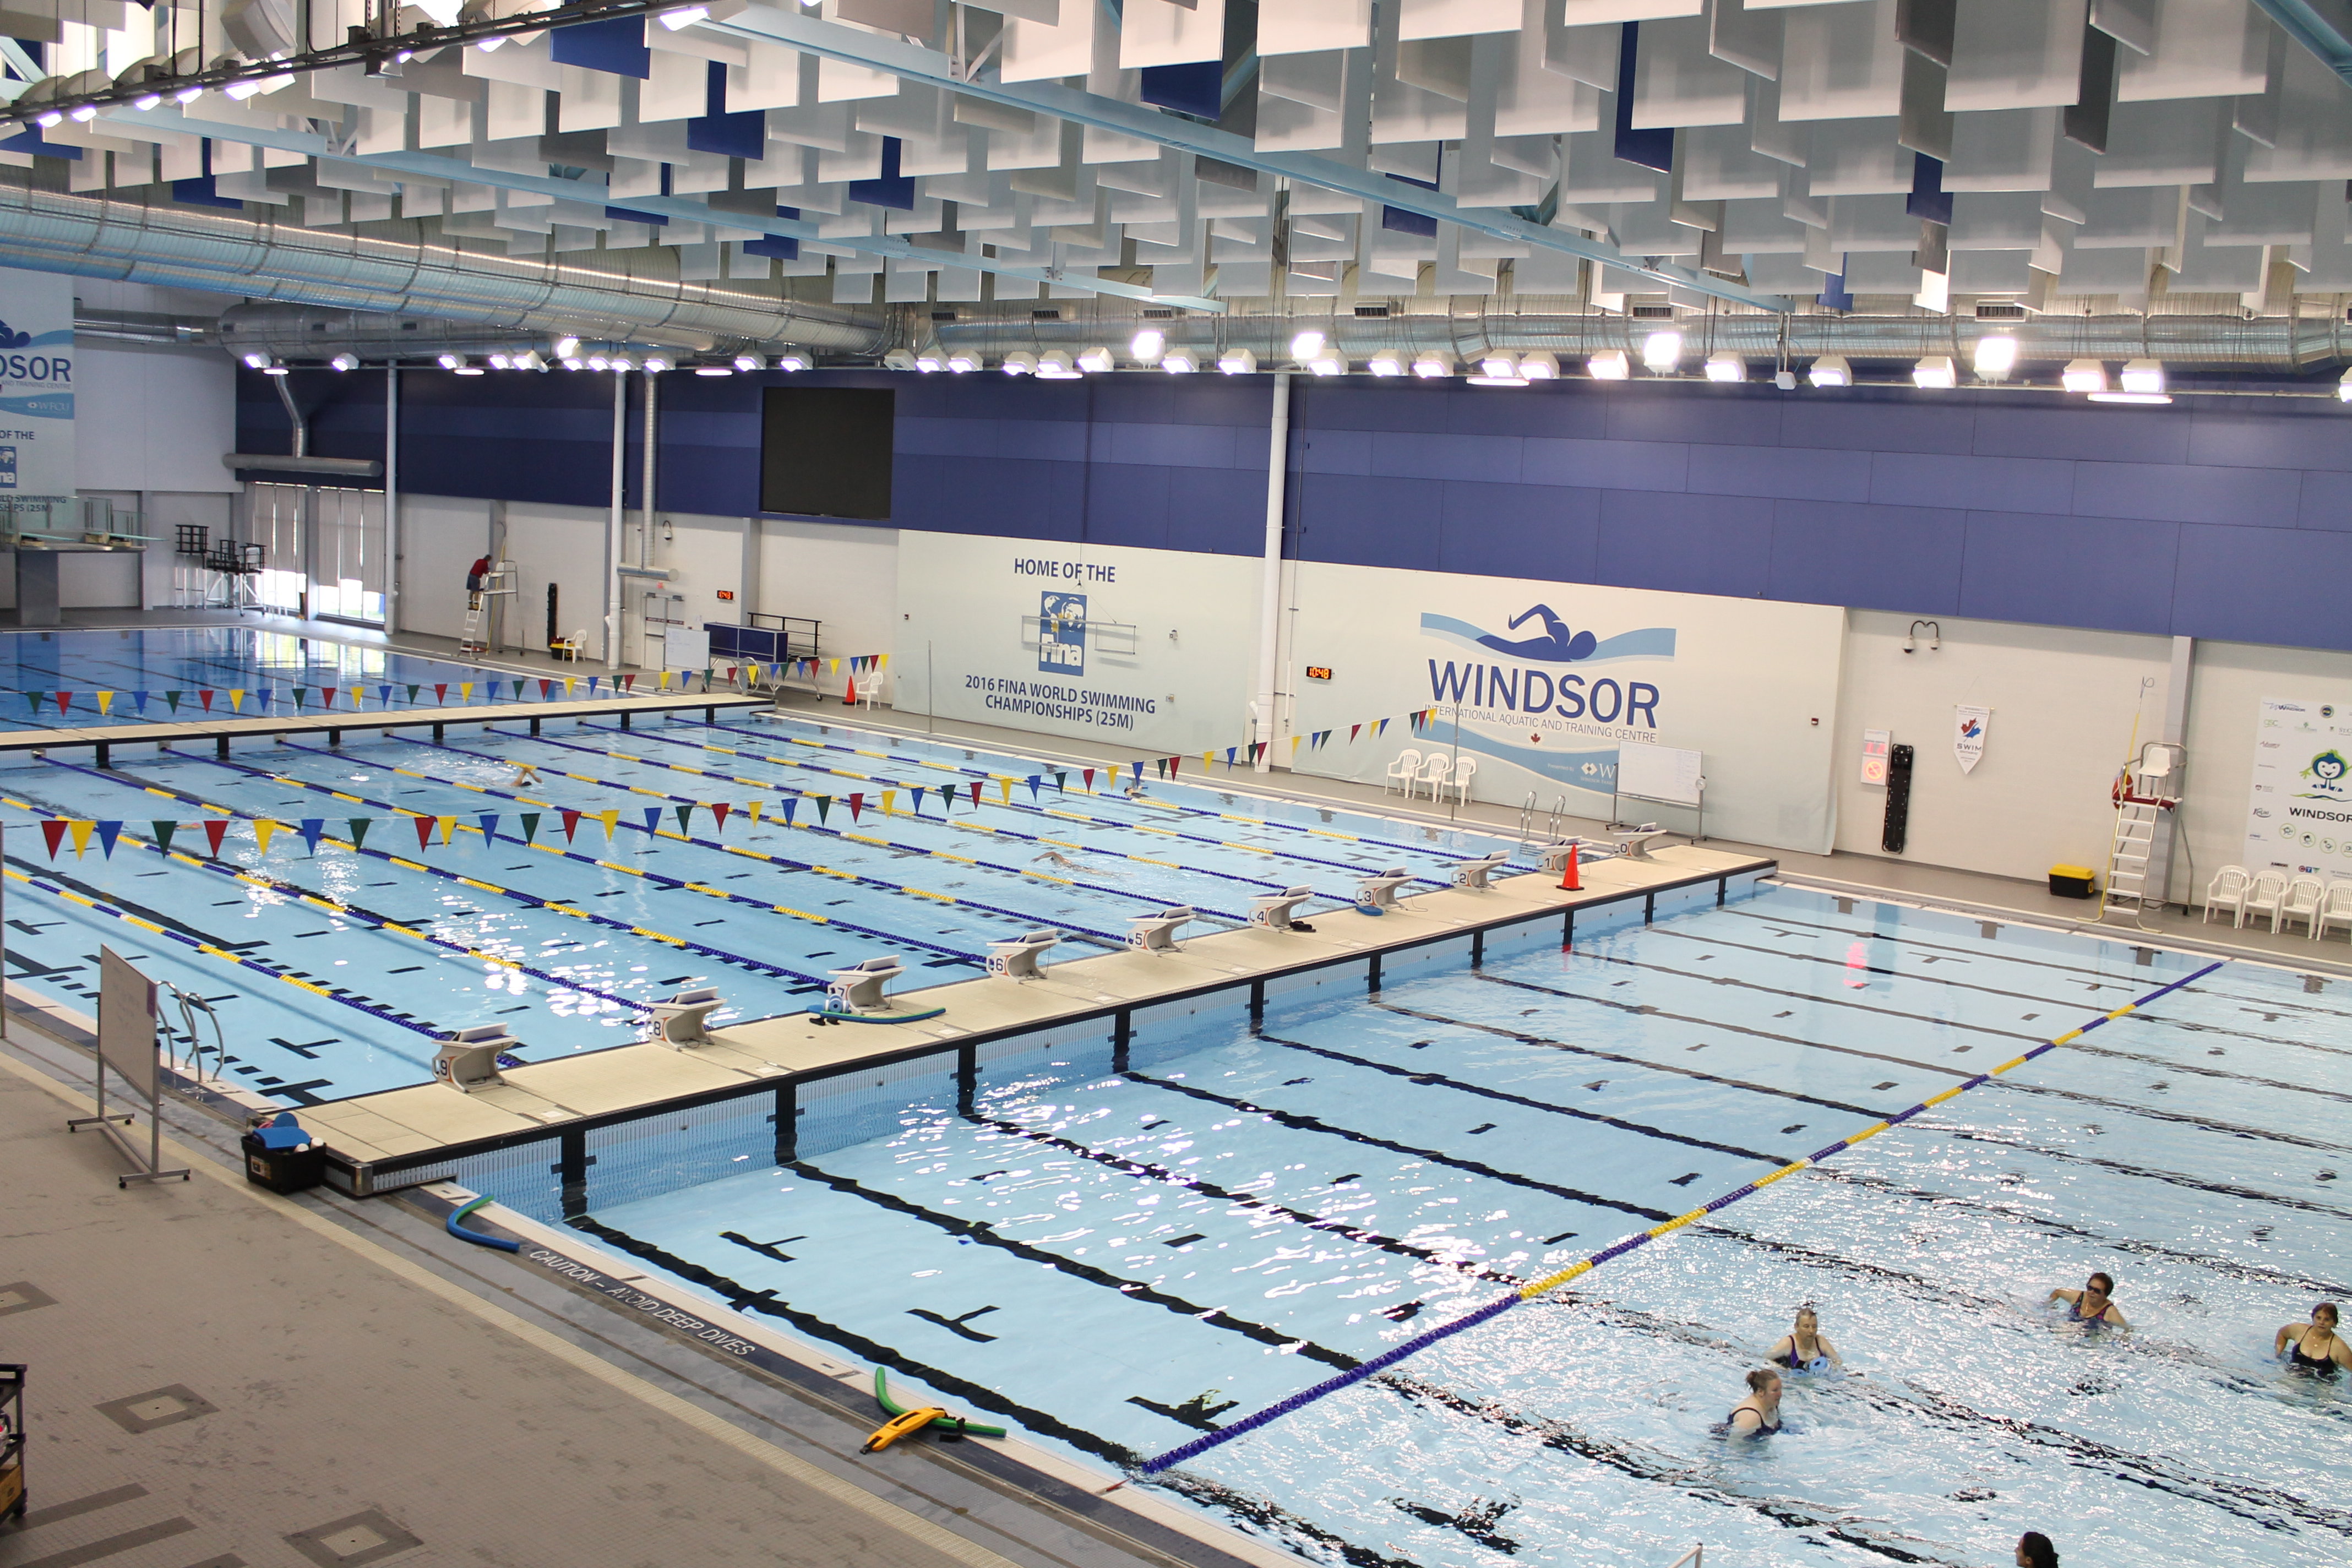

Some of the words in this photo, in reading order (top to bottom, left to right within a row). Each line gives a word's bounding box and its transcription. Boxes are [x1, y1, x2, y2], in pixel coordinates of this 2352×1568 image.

[14, 431, 35, 440] THE
[1014, 558, 1059, 577] HOME
[1063, 562, 1082, 579] OF
[1086, 564, 1115, 582] THE
[1310, 667, 1329, 679] 10:48
[965, 675, 994, 691] 2016
[998, 679, 1027, 696] FINA
[1030, 683, 1077, 703] WORLD
[1081, 690, 1156, 714] SWIMMING
[1428, 658, 1659, 728] WINDSOR
[986, 695, 1092, 723] CHAMPIONSHIPS
[1096, 710, 1134, 731] (25M)
[1499, 715, 1538, 727] AQUATIC
[1542, 720, 1562, 731] AND
[1565, 722, 1612, 737] TRAINING
[1615, 728, 1657, 743] CENTRE
[1957, 743, 1982, 752] SWIM
[2289, 807, 2352, 823] WINDSOR
[1620, 843, 1627, 853] 0
[1545, 858, 1549, 868] 1
[2299, 865, 2320, 874] CTV
[1460, 873, 1466, 884] 2
[1364, 891, 1371, 902] 3
[1256, 911, 1264, 922] 4
[1135, 933, 1142, 945] 5
[996, 958, 1003, 971] 6
[837, 987, 845, 997] 7
[654, 1021, 661, 1036] 8
[440, 1060, 448, 1075] 9
[530, 1250, 601, 1283] CAUTION
[605, 1287, 660, 1311] AVOID
[653, 1308, 705, 1331] DEEP
[698, 1328, 756, 1356] DIVES
